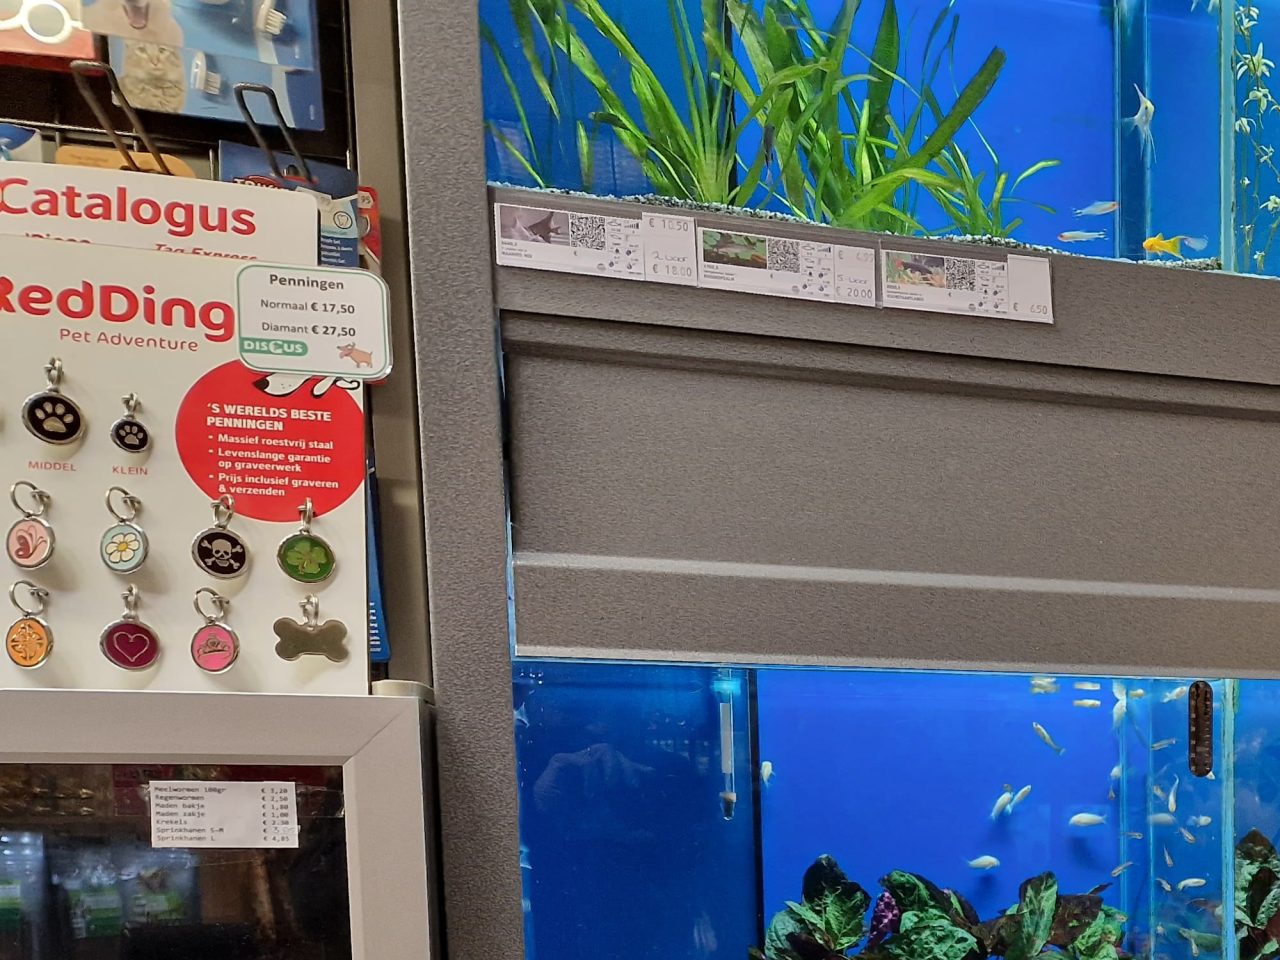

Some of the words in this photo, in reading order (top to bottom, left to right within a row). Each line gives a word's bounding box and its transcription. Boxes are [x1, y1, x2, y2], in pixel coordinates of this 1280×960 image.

[0, 177, 257, 237] Catalogus
[269, 274, 344, 291] Penningen
[260, 298, 308, 311] Normaal
[310, 302, 319, 312] €
[322, 303, 355, 314] 17,50
[261, 322, 309, 334] Diamant
[311, 325, 319, 334] €
[322, 326, 356, 337] 27,50
[59, 328, 91, 343] Pet
[96, 331, 199, 352] Adventure
[223, 404, 288, 418] WERELDS
[290, 409, 332, 421] BESTE
[206, 416, 284, 431] PENNINGEN
[217, 433, 259, 445] Massief
[261, 437, 306, 449] roestvrij
[308, 440, 334, 449] staal
[217, 448, 285, 461] Levenslange
[287, 452, 331, 463] garantie
[27, 461, 77, 472] MIDDEL
[112, 466, 148, 475] KLEIN
[218, 461, 232, 469] op
[234, 461, 302, 472] graveerwerk
[218, 473, 242, 484] Prijs
[245, 474, 289, 485] inclusief
[291, 478, 339, 488] graveren
[218, 484, 227, 493] &
[229, 485, 286, 496] verzenden
